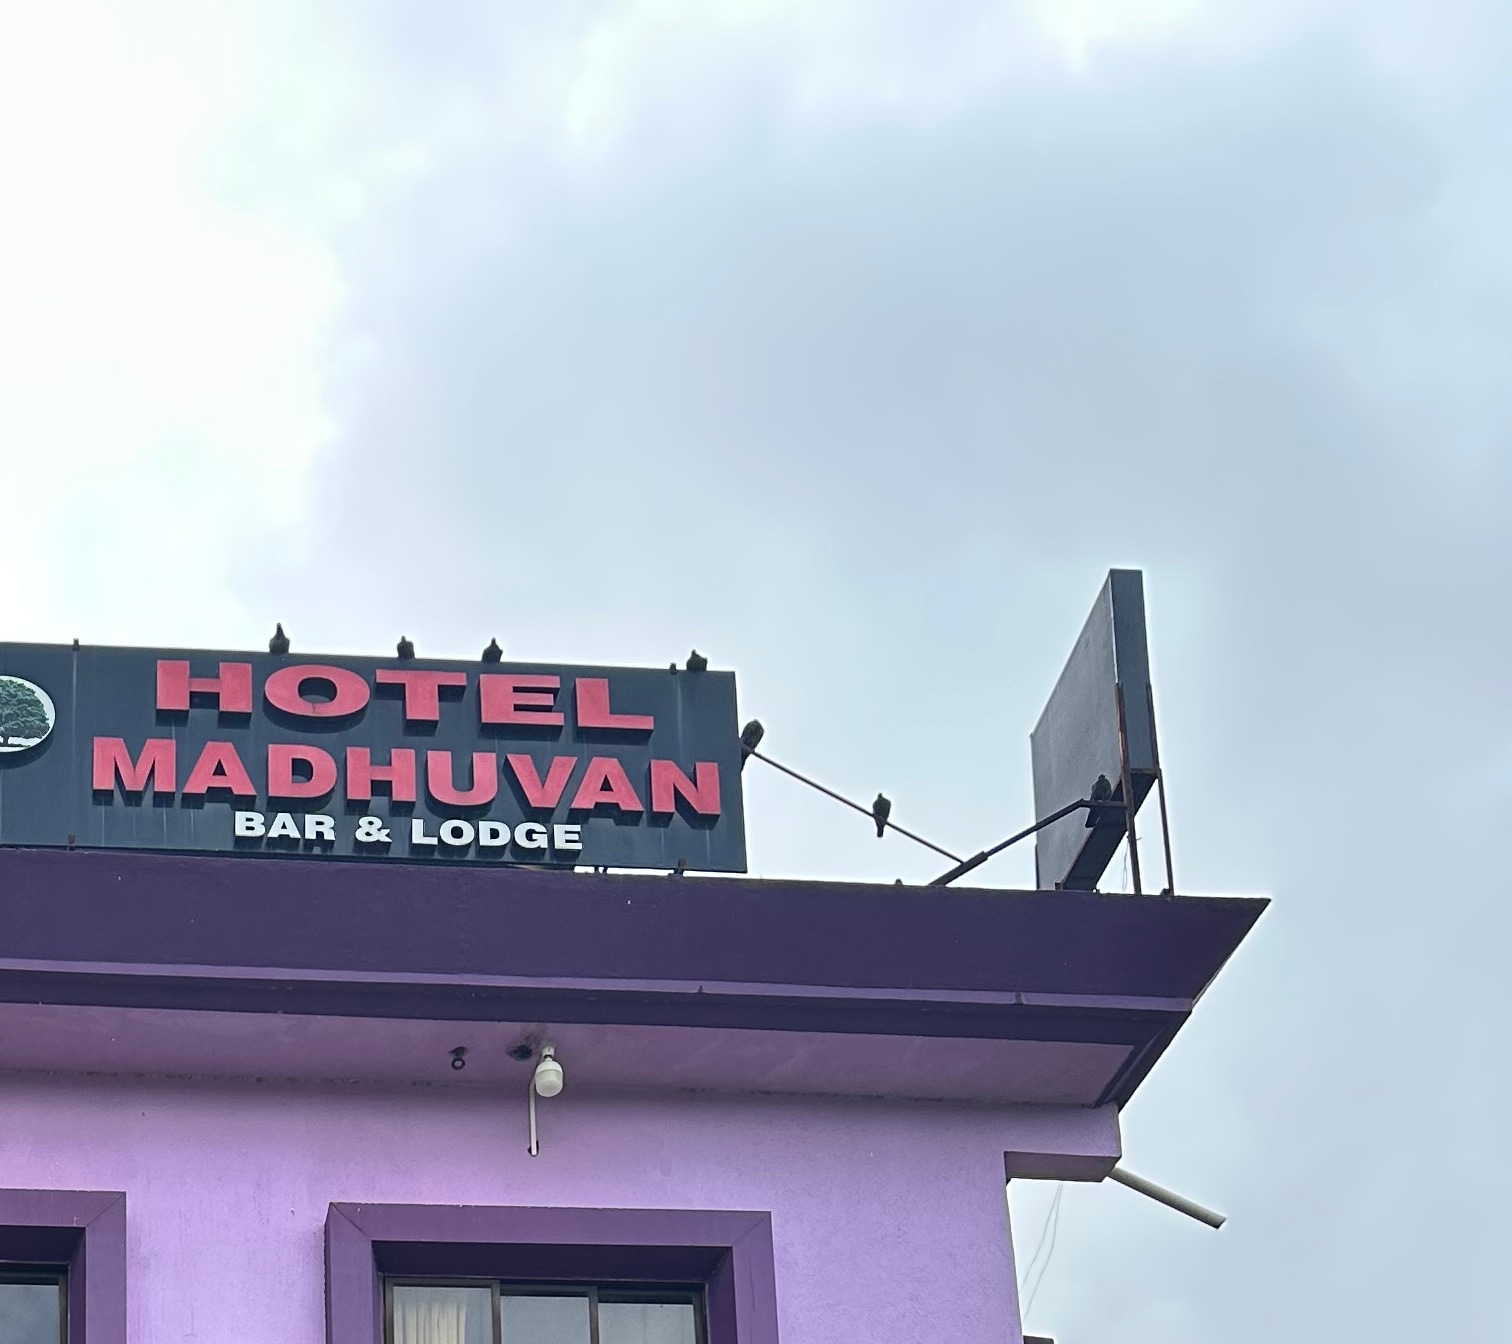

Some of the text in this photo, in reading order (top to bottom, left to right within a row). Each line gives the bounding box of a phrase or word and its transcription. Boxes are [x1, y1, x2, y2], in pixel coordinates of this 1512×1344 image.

[155, 659, 655, 731] HOTEL
[93, 736, 720, 815] MADHUVAN
[234, 810, 583, 852] BAR & LODGE
